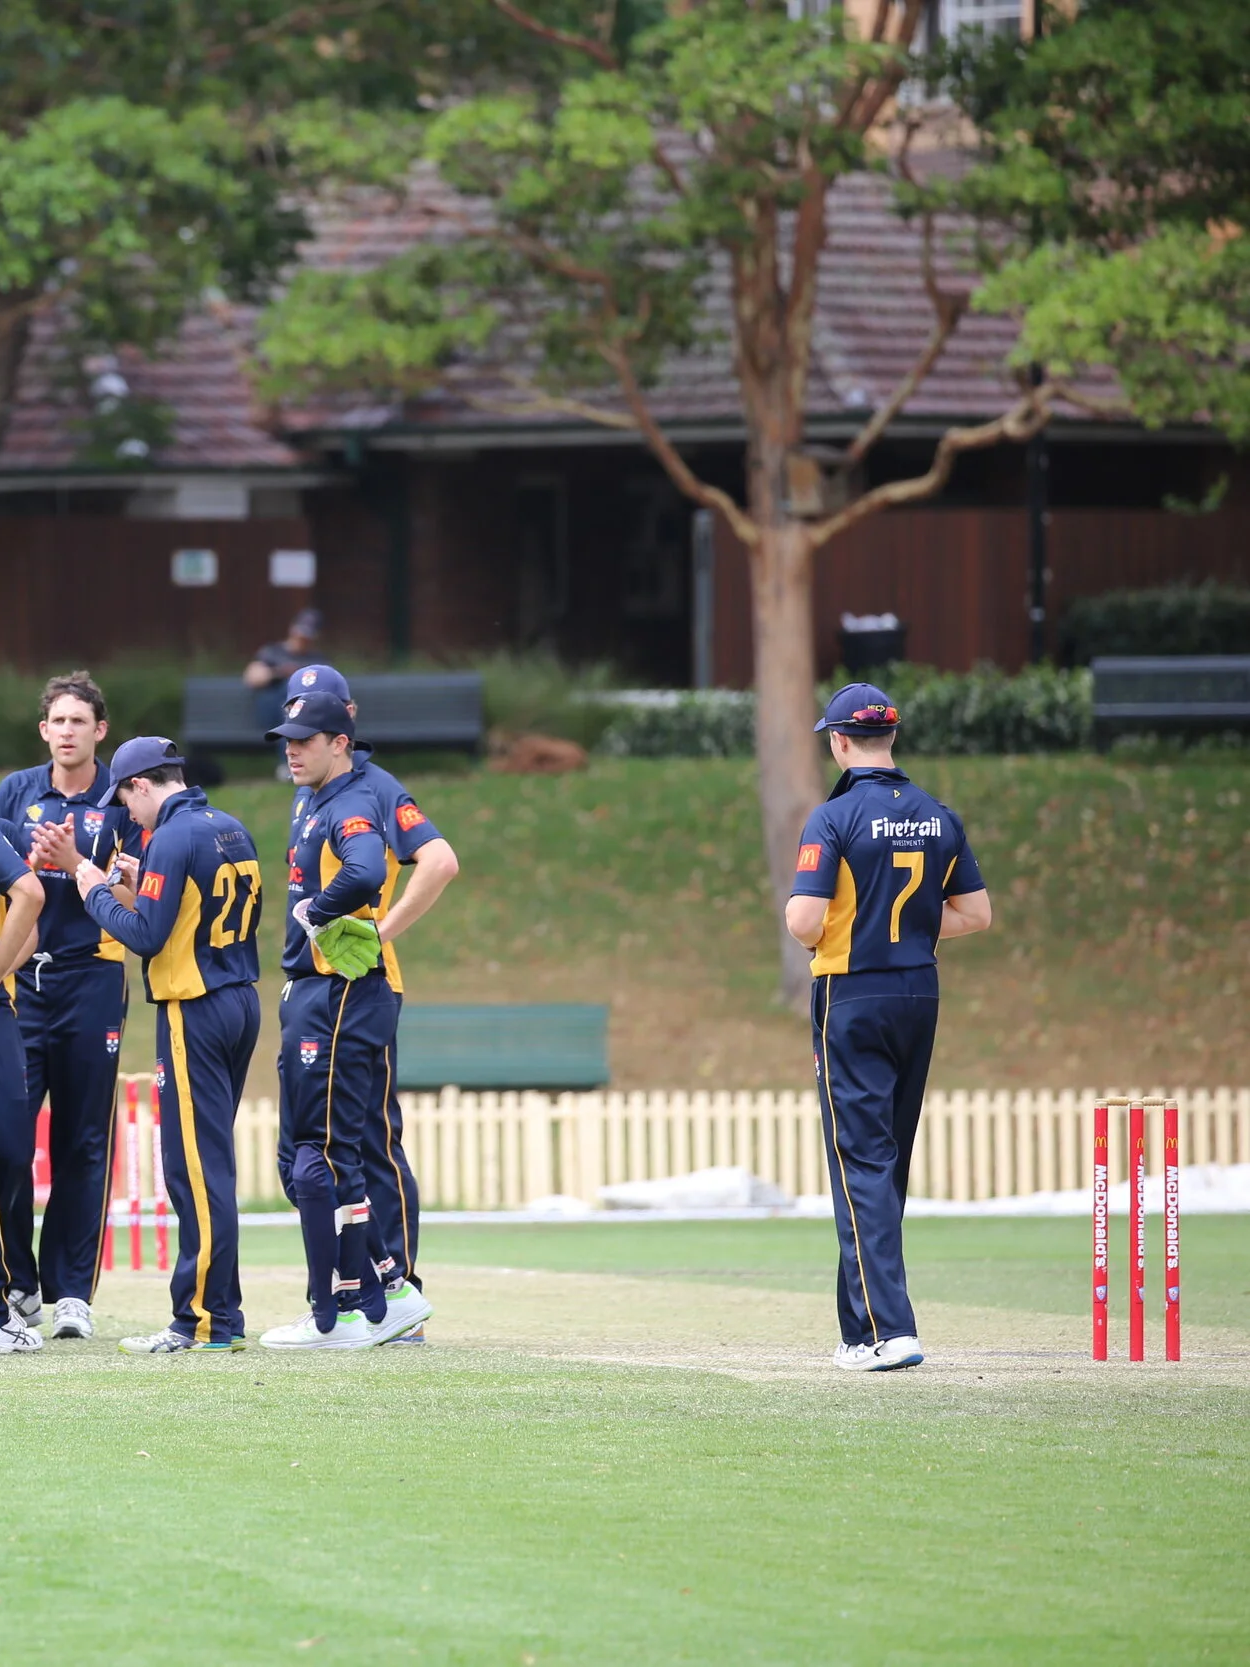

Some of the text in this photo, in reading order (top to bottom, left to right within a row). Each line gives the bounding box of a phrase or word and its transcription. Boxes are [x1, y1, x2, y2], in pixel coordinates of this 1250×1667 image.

[871, 816, 941, 839] Firetrail
[892, 839, 925, 847] INVESTMENTS
[209, 860, 262, 949] 27
[890, 851, 924, 943] 7
[1094, 1164, 1107, 1269] McDonald's
[1166, 1165, 1179, 1270] McDonald's
